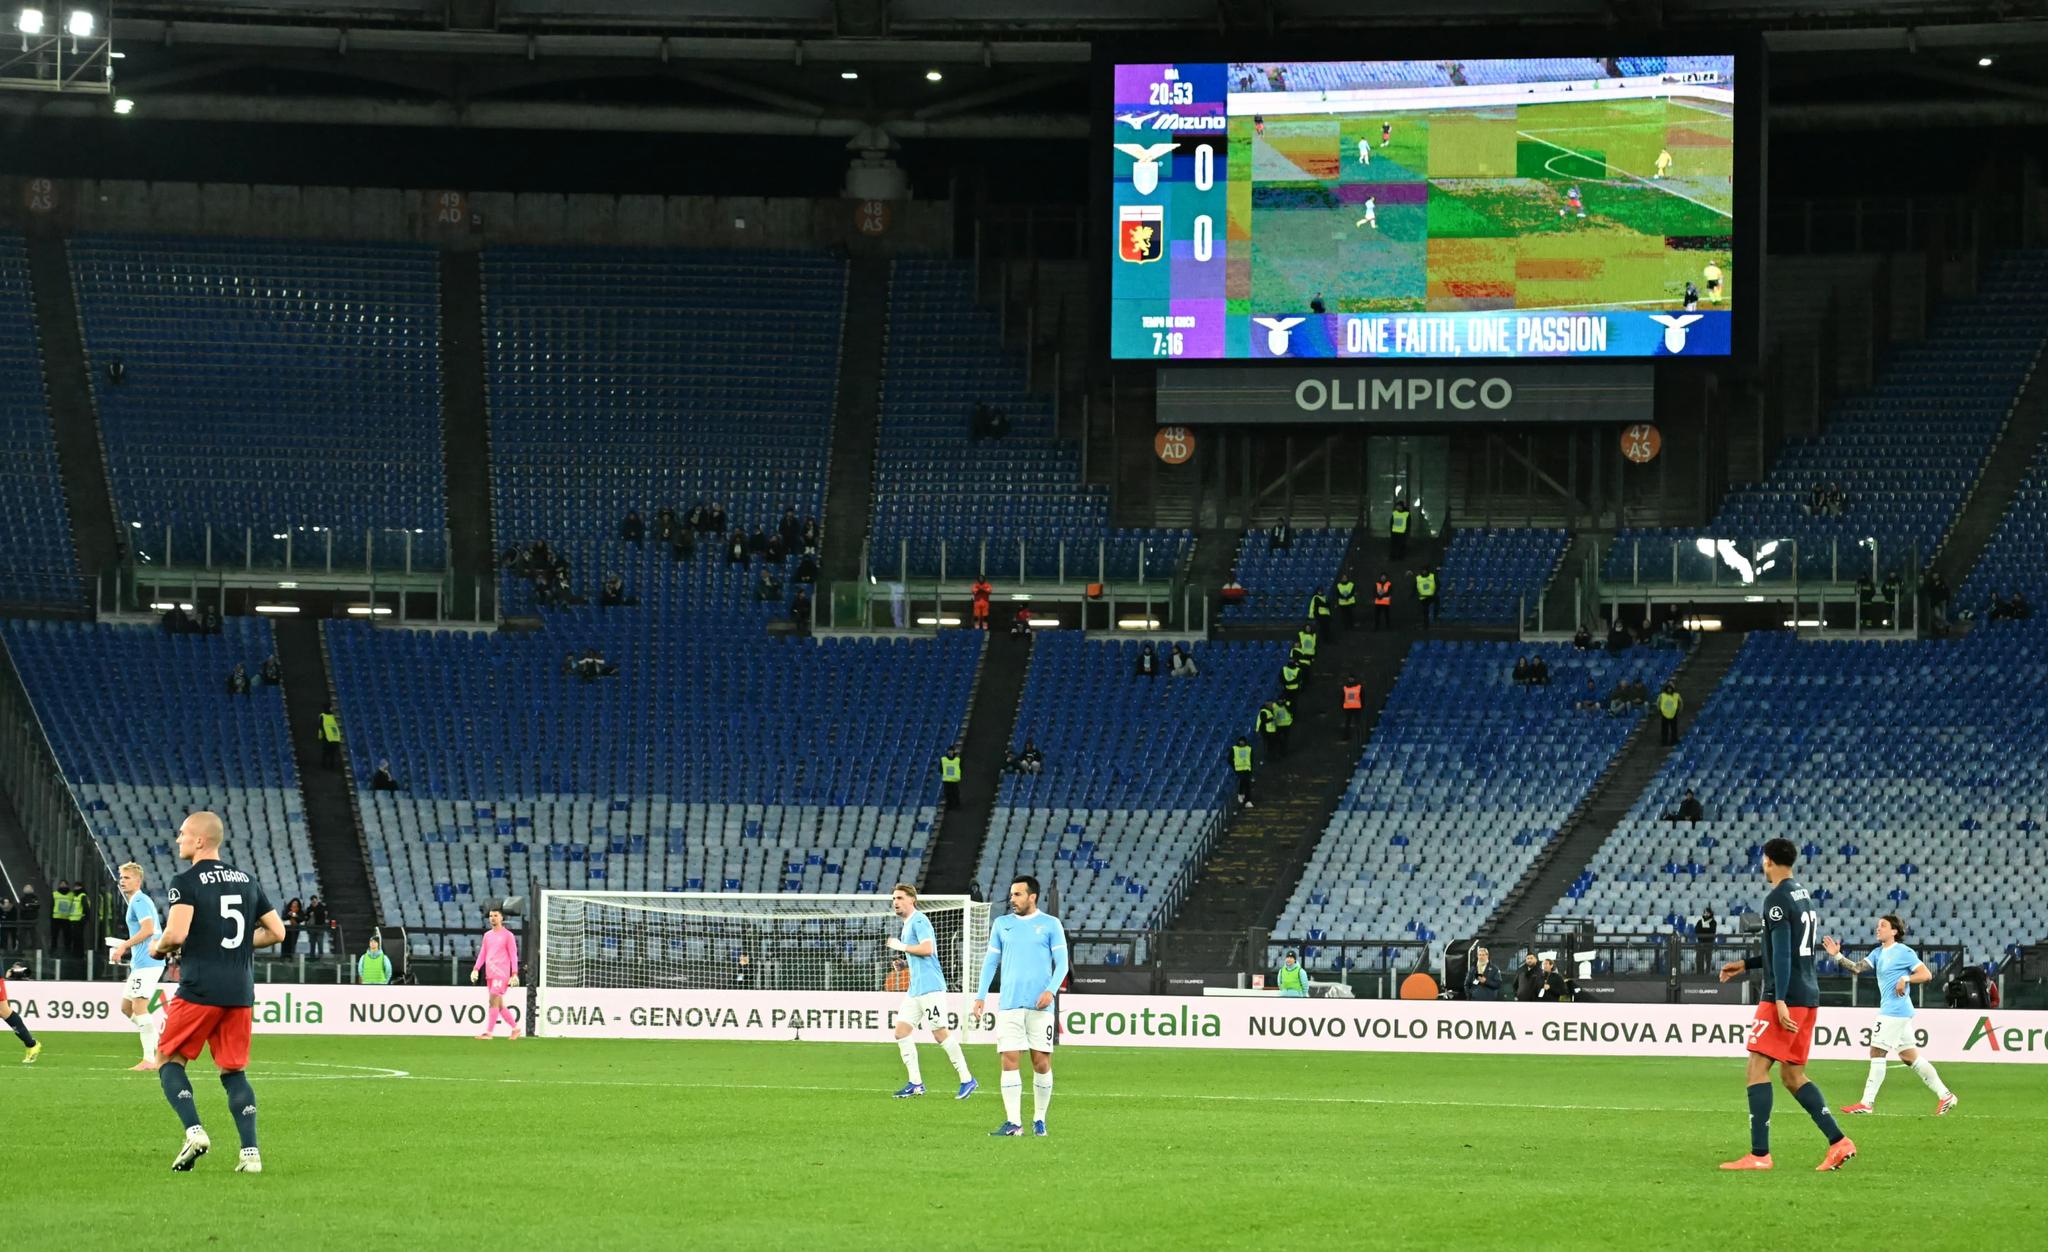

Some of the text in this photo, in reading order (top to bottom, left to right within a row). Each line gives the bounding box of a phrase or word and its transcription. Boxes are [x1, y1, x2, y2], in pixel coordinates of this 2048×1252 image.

[1149, 82, 1193, 105] 20:53
[1195, 143, 1213, 191] 0
[1194, 214, 1213, 262] 0
[1152, 332, 1184, 355] 7:16
[1347, 316, 1607, 356] ONE FAITH, ONE PASSION
[1295, 378, 1513, 411] OLIMPICO
[1165, 427, 1185, 441] 48
[1630, 424, 1650, 440] 47
[1162, 443, 1187, 458] AD
[1629, 441, 1651, 458] AS
[220, 894, 245, 949] 5
[1799, 910, 1817, 957] 27
[47, 1000, 109, 1019] 39.99
[350, 1003, 442, 1023] NUOVO
[450, 1004, 521, 1024] VOO
[630, 1006, 737, 1028] GENOVA
[747, 1008, 764, 1028] A
[772, 1009, 879, 1029] PARTIRE
[925, 1005, 941, 1020] 24
[1060, 1005, 1222, 1037] eroitalia
[1046, 1025, 1054, 1041] 9
[1249, 1016, 1346, 1037] NUOVO
[1353, 1018, 1428, 1039] VOLO
[1437, 1020, 1517, 1040] ROMA
[1542, 1021, 1657, 1043] GENOVA
[1664, 1023, 1683, 1043] A
[1748, 1019, 1770, 1037] 27
[1814, 1026, 1852, 1046] DA
[1962, 1016, 2048, 1051] Aer
